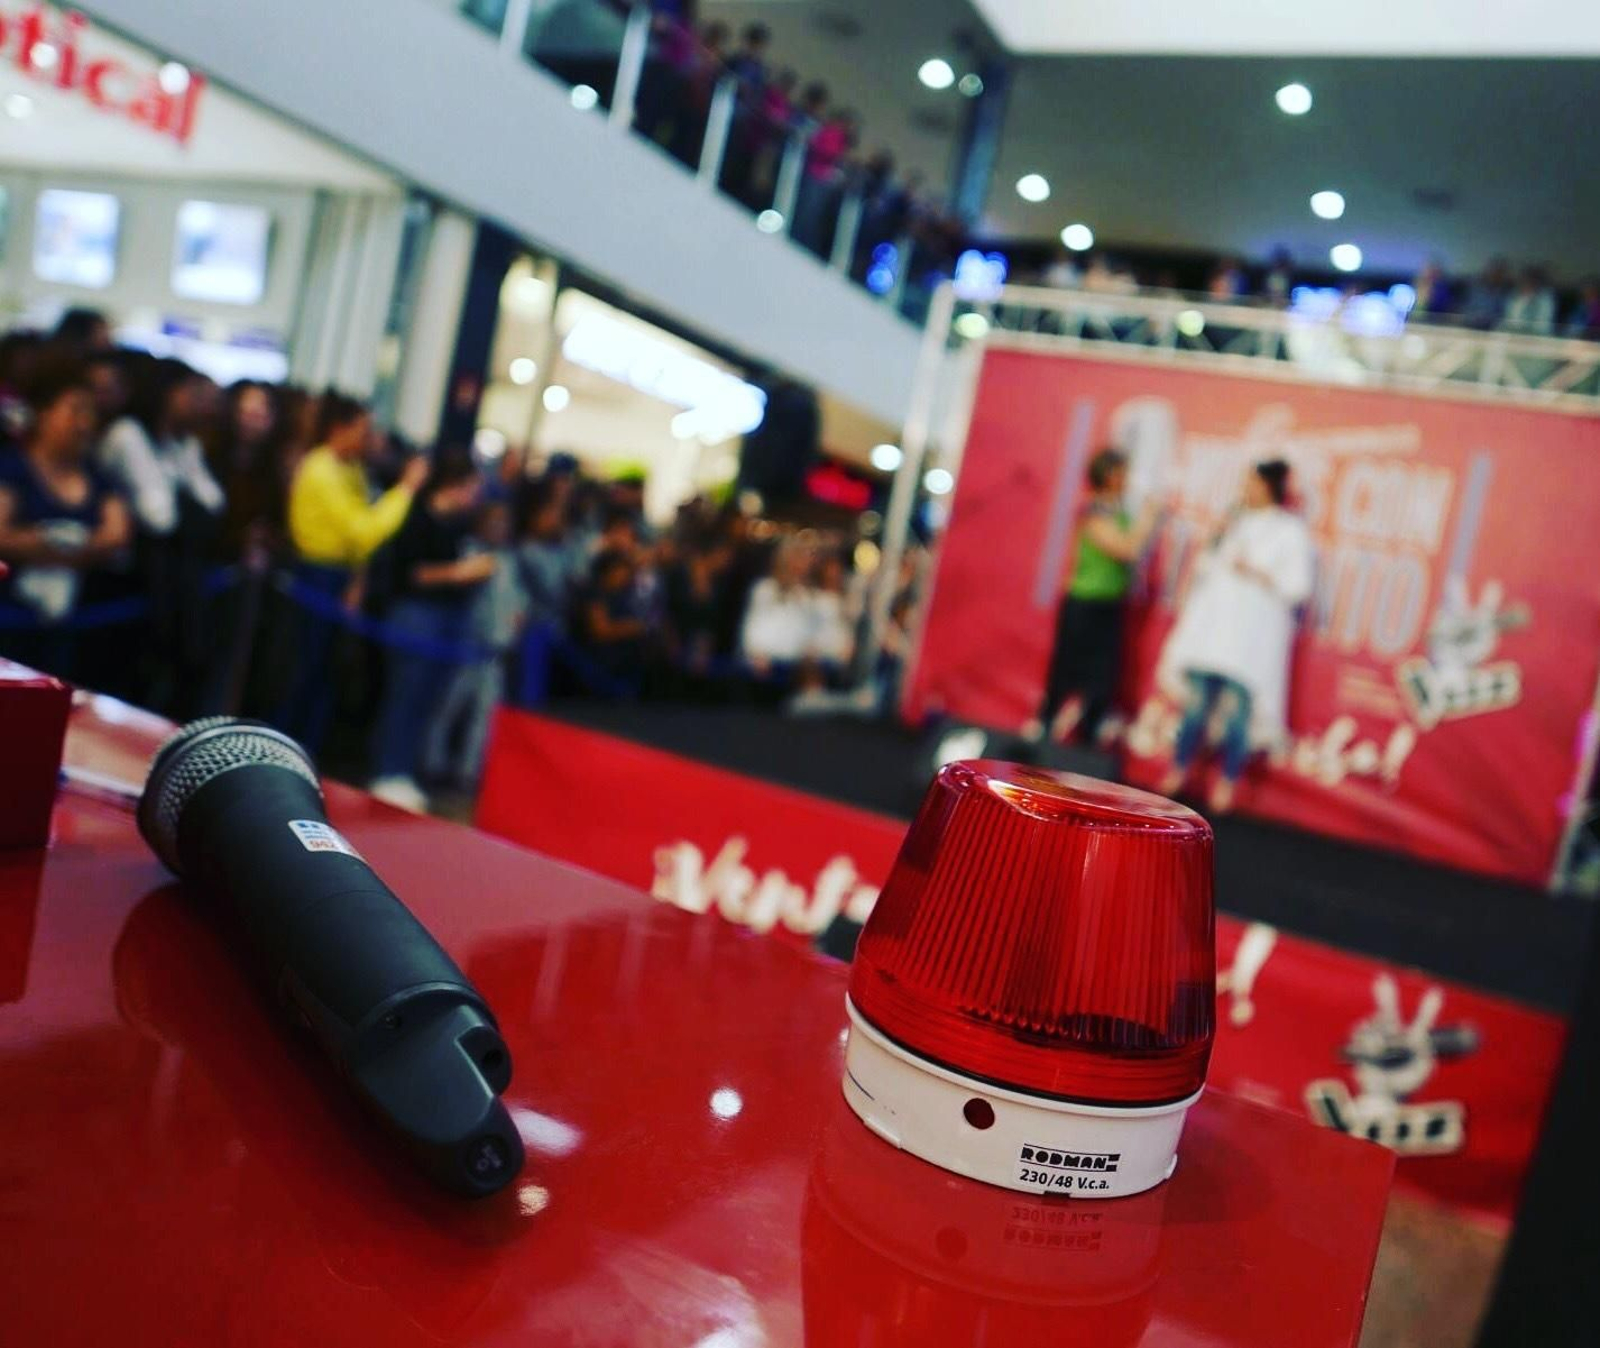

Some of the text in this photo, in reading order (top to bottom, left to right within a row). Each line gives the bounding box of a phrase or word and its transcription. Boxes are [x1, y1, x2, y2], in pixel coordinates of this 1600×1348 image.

[0, 8, 206, 146] tical
[1021, 1146, 1107, 1169] RODMAN
[1019, 1168, 1110, 1190] 230/48 V.c.a.
